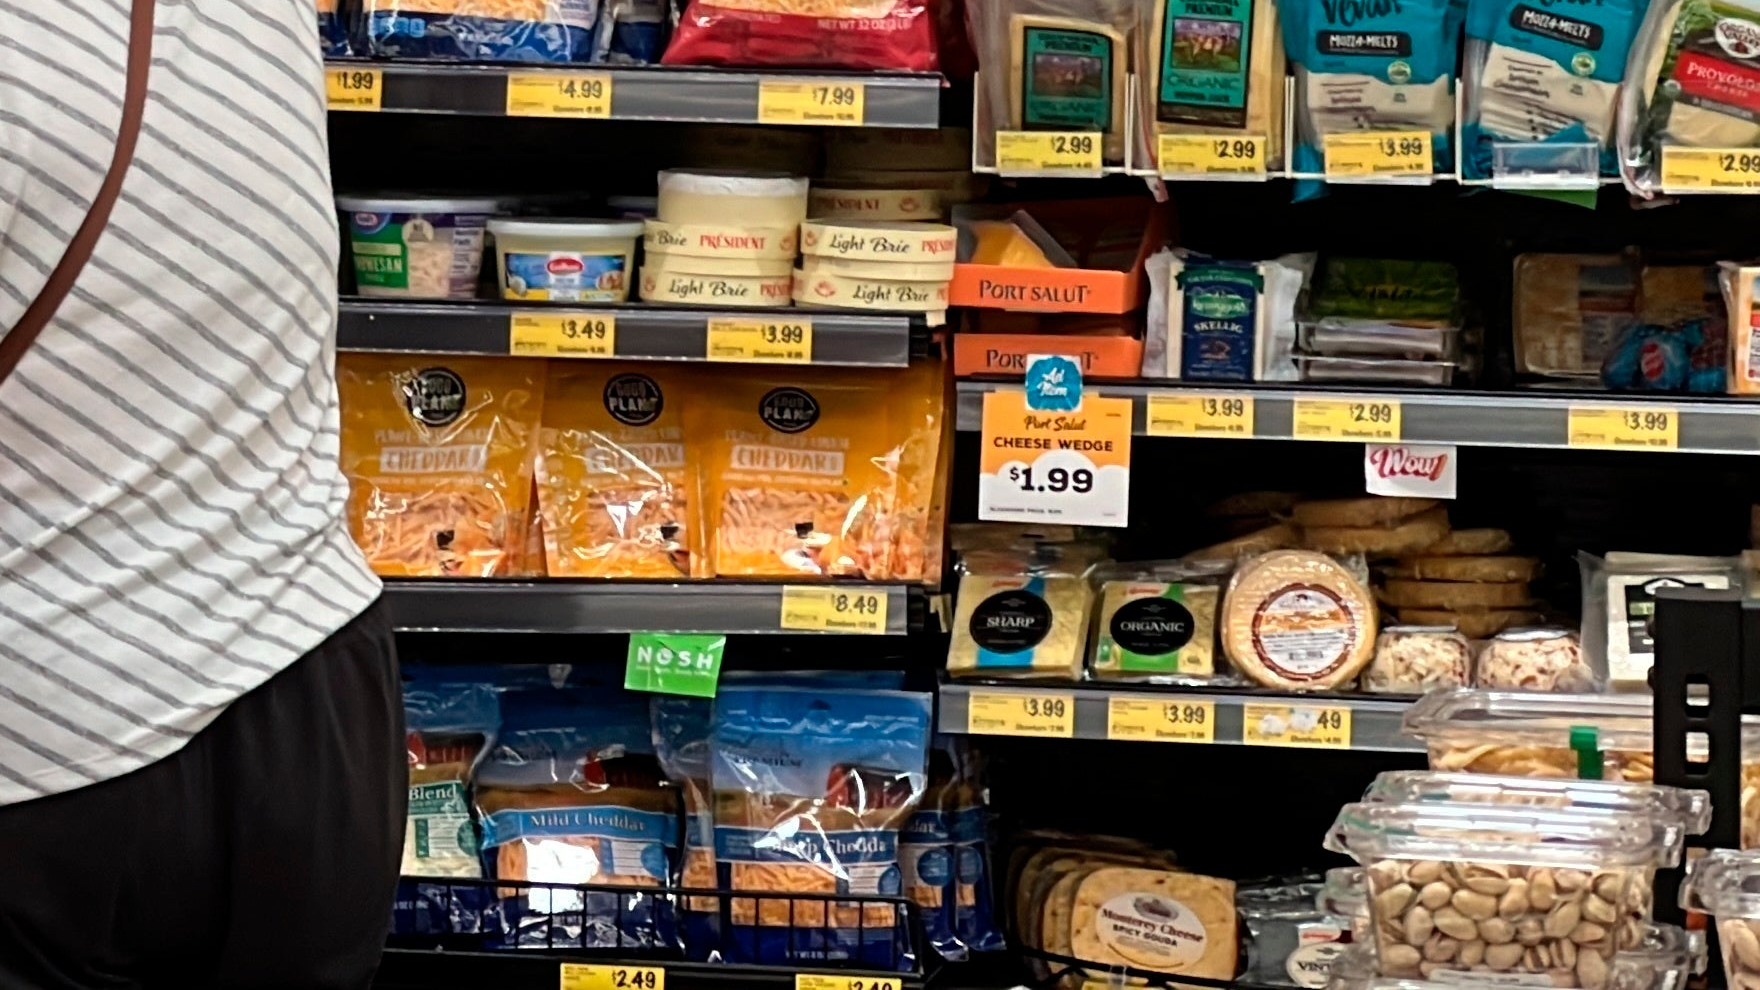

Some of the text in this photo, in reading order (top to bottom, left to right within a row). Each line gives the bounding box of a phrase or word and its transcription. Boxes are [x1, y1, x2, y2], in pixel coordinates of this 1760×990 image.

[1522, 10, 1591, 39] MOZZA-MELTS
[1329, 33, 1399, 49] MOZZA-MELTS
[559, 79, 602, 100] $4.99
[813, 85, 855, 106] $7.99
[1051, 137, 1092, 155] $2.99
[1214, 141, 1256, 159] $2.99
[1381, 139, 1422, 156] $3.99
[658, 231, 687, 247] Brie
[829, 236, 911, 256] Light Brie
[669, 279, 749, 298] Light Brie
[853, 284, 929, 302] Light Brie
[979, 279, 1090, 305] PORT SALUT
[562, 321, 606, 340] $3.49
[761, 325, 803, 344] $3.99
[1194, 320, 1243, 334] SKELLIG
[1024, 415, 1086, 432] Port Salut
[993, 436, 1113, 452] CHEESE WEDGE
[1370, 447, 1448, 481] Wow!
[1010, 466, 1093, 493] $1.99
[986, 615, 1035, 629] SHARP
[1120, 620, 1185, 634] ORGANIC
[637, 646, 714, 670] NOSH
[408, 784, 456, 803] Blend
[529, 811, 646, 833] Mild Cheddar
[1101, 908, 1204, 943] Monterey Cheese
[612, 969, 656, 989] $2.49
